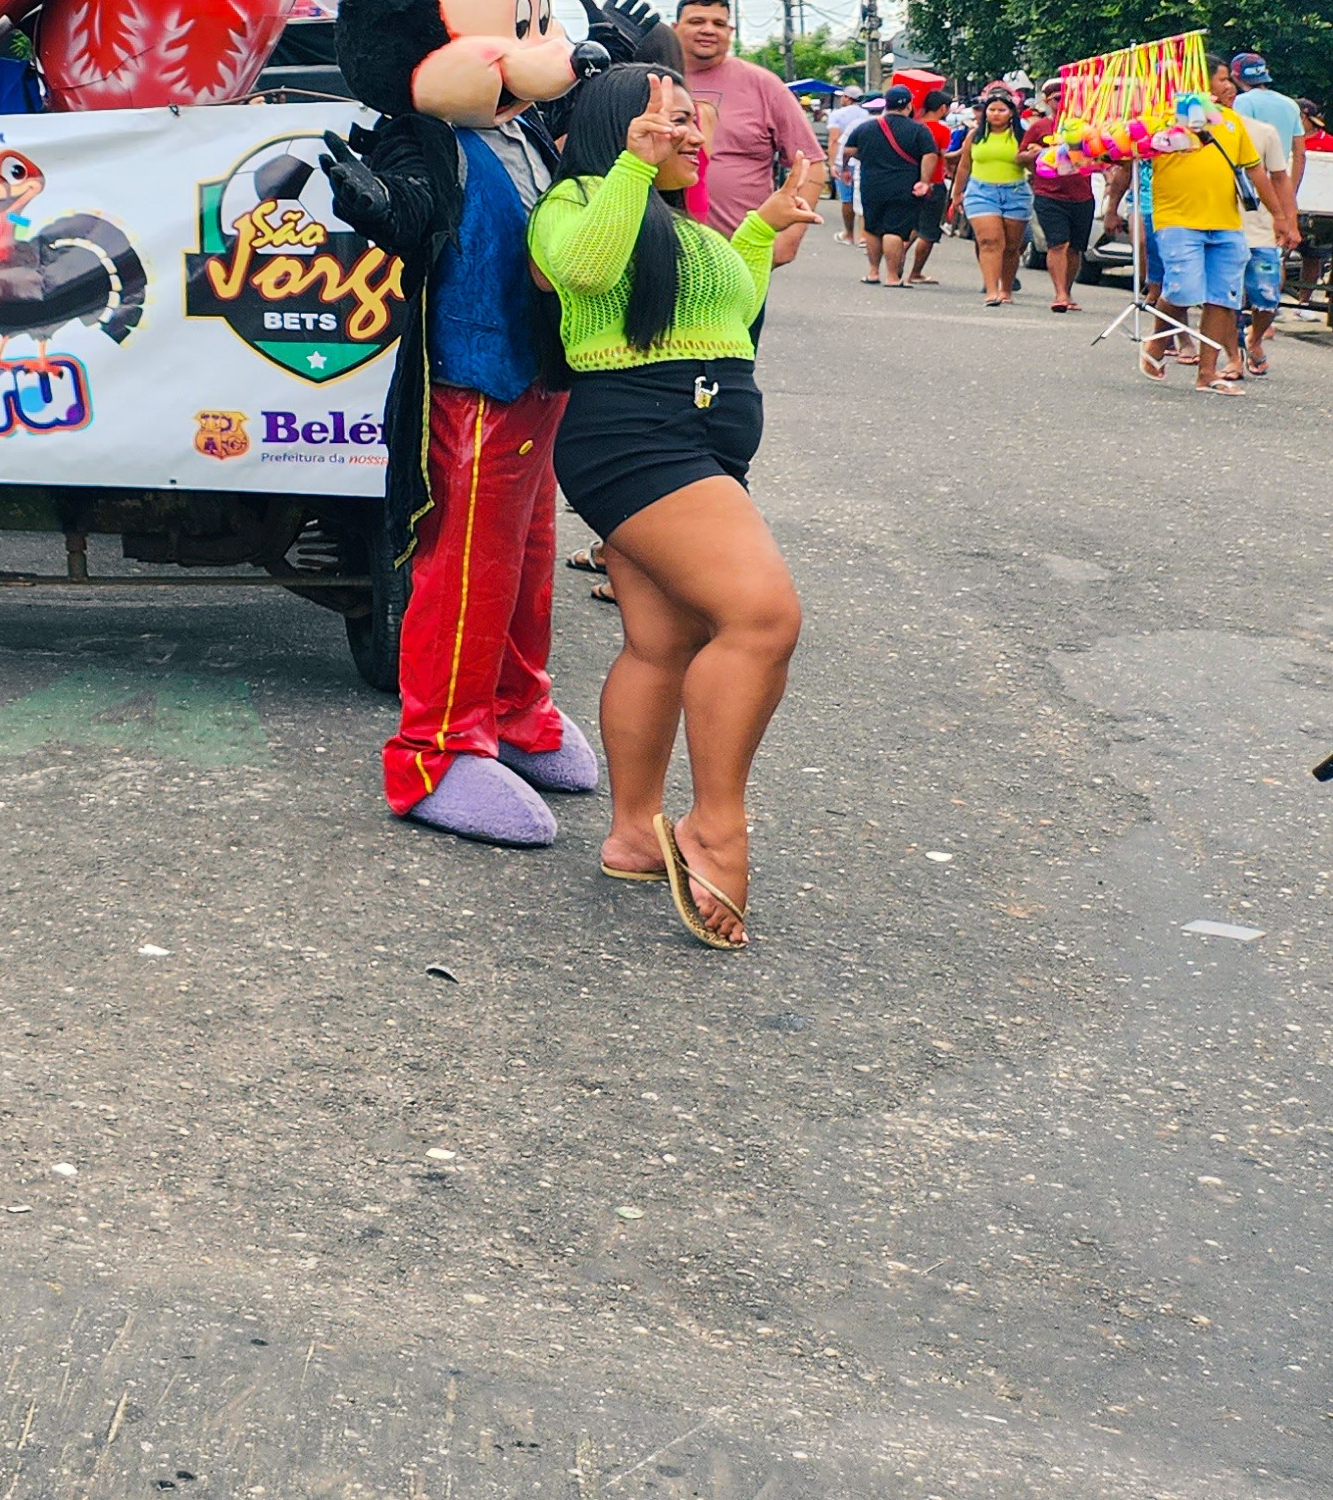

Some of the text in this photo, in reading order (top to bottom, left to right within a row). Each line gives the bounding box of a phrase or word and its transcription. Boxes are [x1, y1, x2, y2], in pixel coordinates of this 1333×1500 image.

[250, 198, 327, 248] São
[263, 311, 338, 331] BETS
[260, 410, 386, 445] Belé
[261, 452, 325, 463] Prefeitura
[328, 451, 345, 464] da
